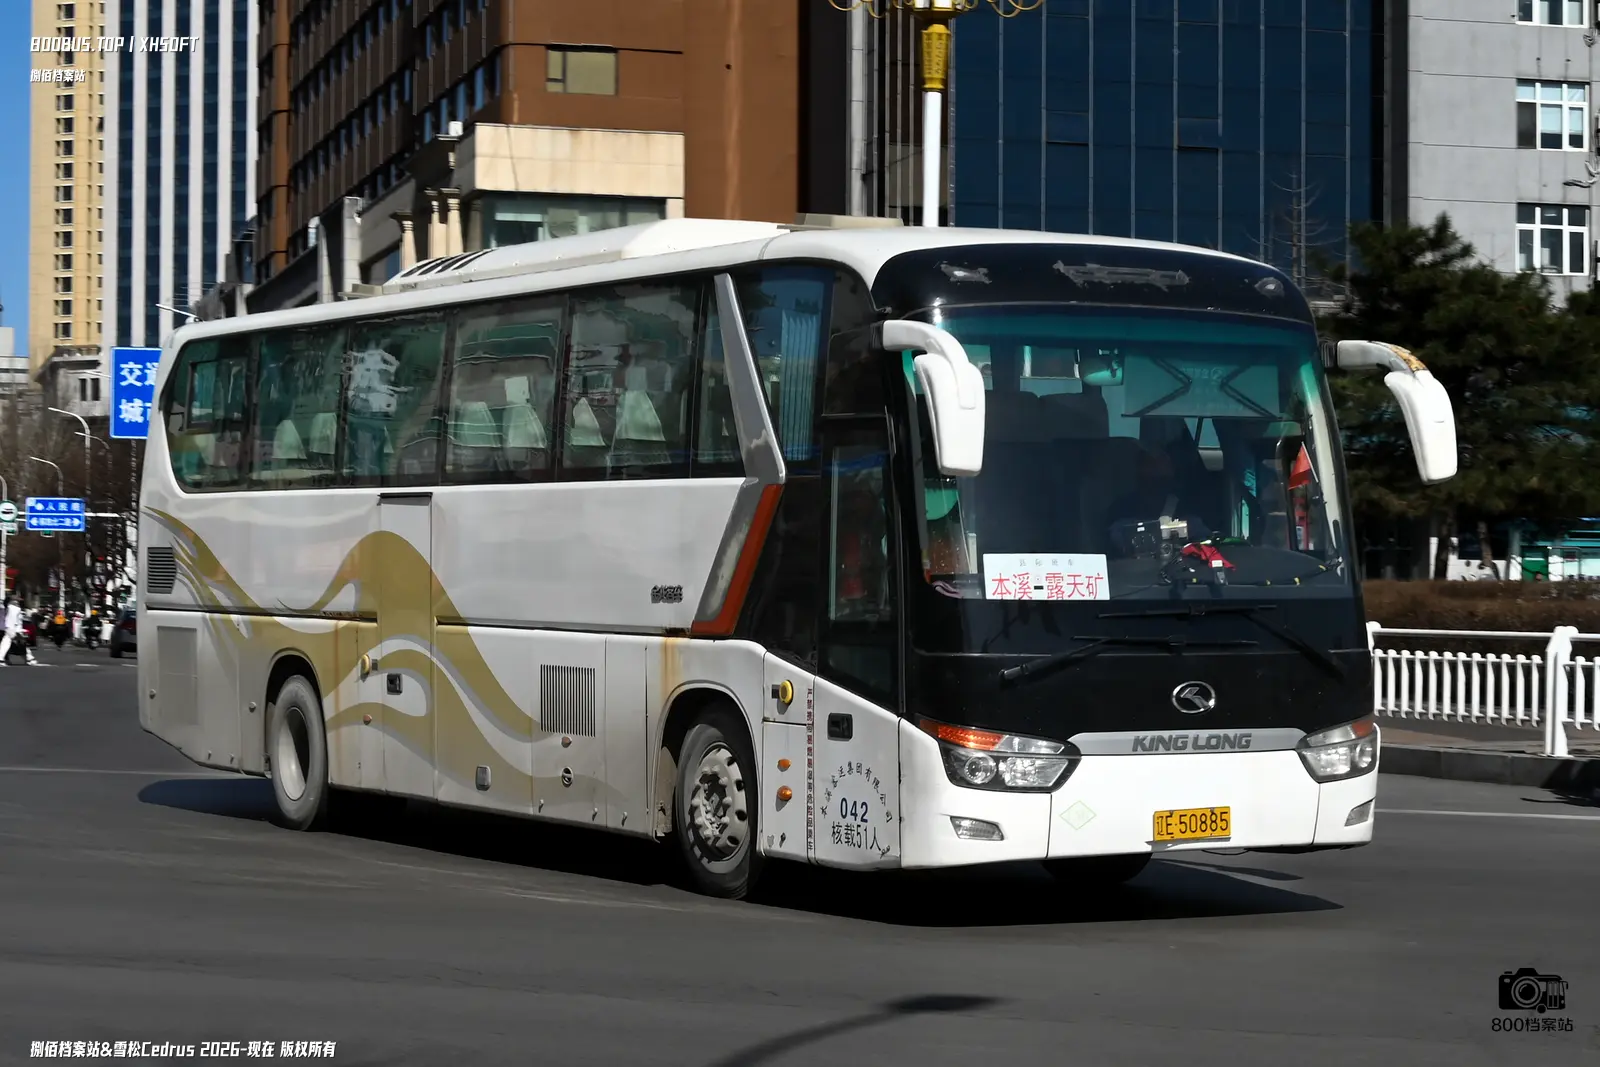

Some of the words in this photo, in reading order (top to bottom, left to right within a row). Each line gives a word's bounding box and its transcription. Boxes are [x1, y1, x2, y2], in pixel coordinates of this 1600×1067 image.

[1131, 734, 1189, 752] KING
[1191, 733, 1252, 750] LONG
[840, 797, 869, 823] 042
[831, 821, 881, 851] 核载51人
